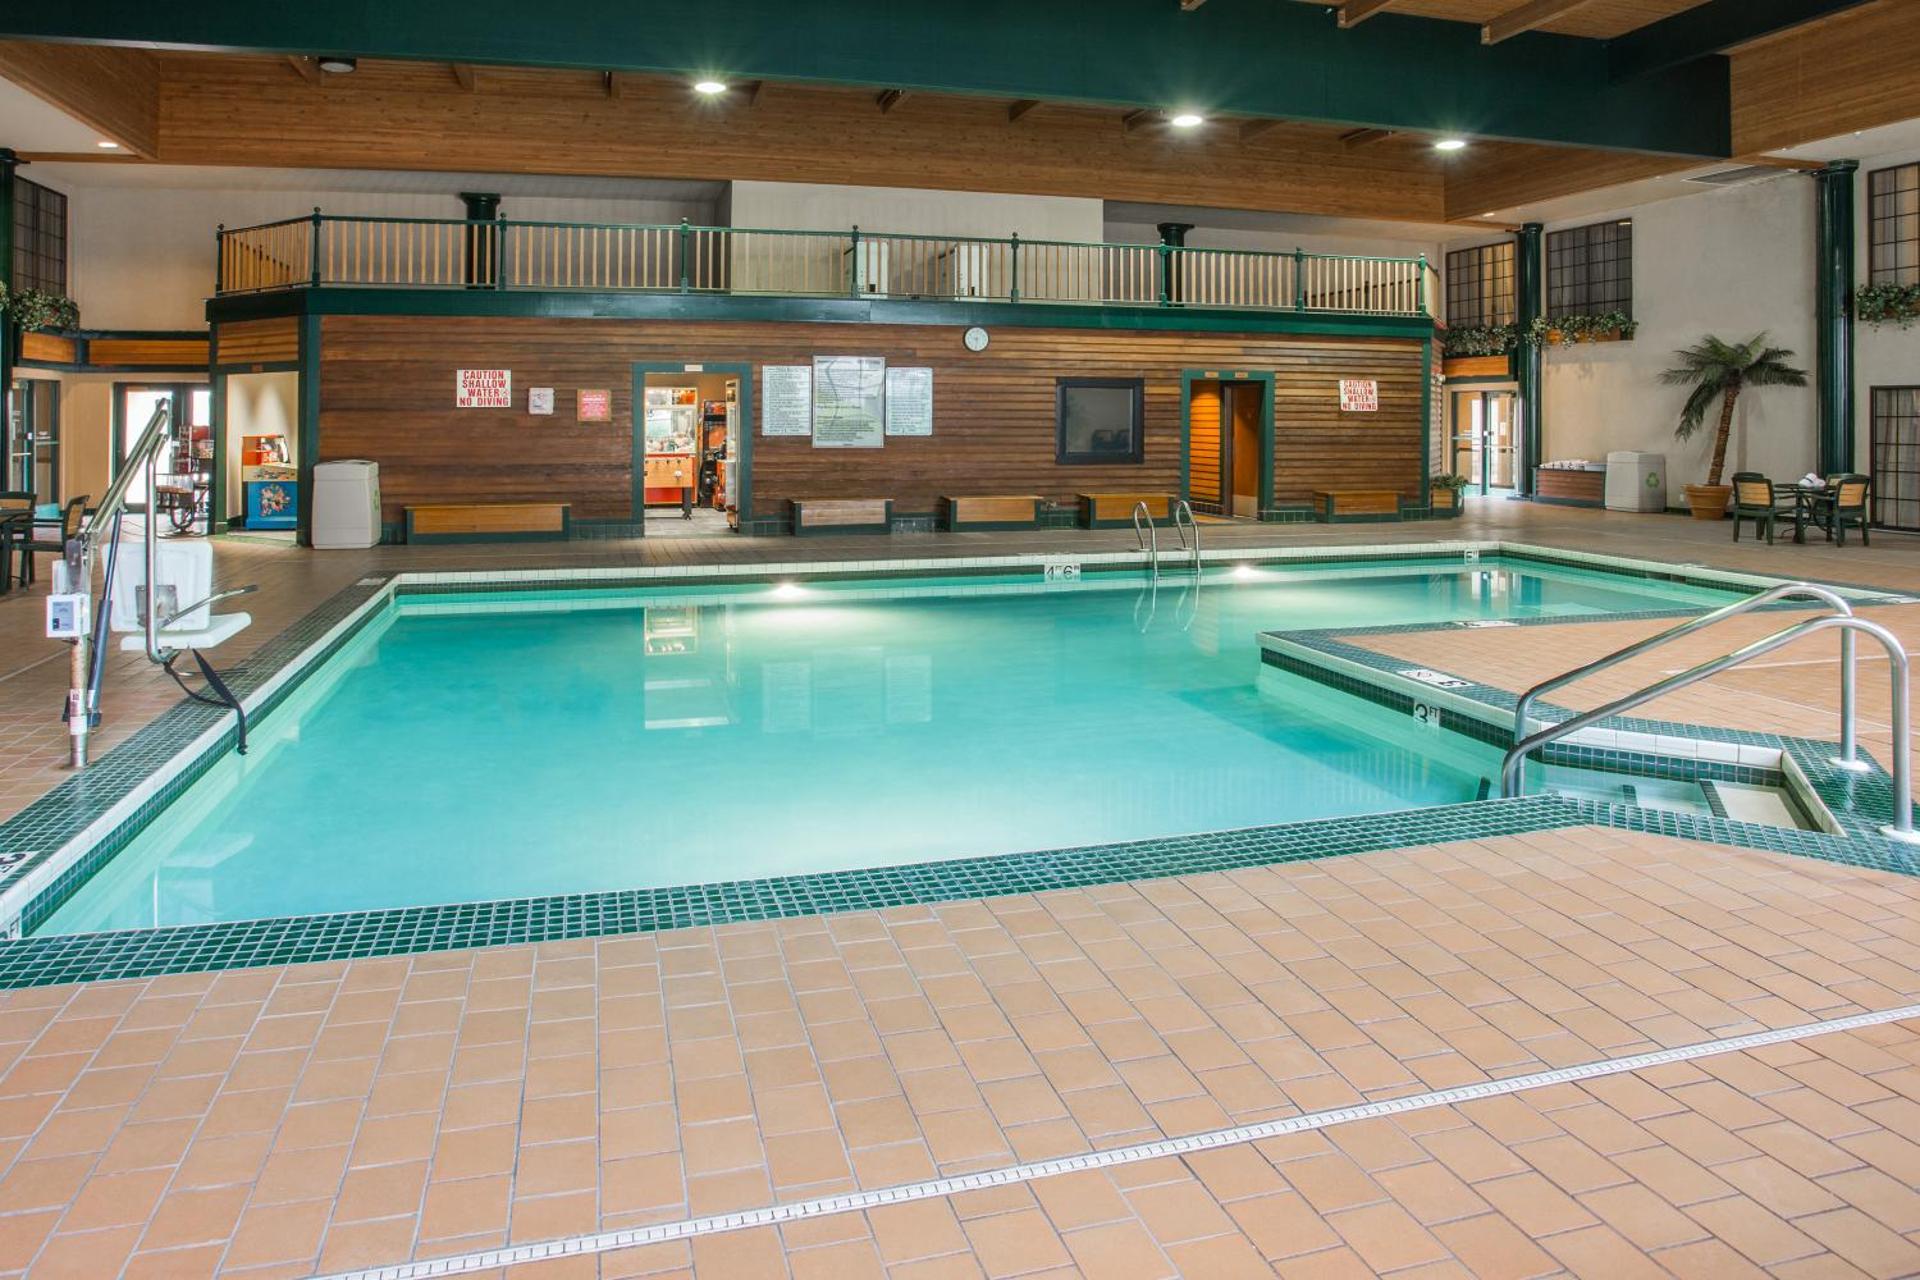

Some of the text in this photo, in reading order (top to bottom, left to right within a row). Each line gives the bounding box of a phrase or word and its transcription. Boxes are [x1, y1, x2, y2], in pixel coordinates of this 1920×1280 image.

[463, 370, 504, 379] CAUTION
[462, 380, 506, 388] SHALLOW
[467, 388, 499, 397] WATER
[460, 397, 509, 406] NO DIVING
